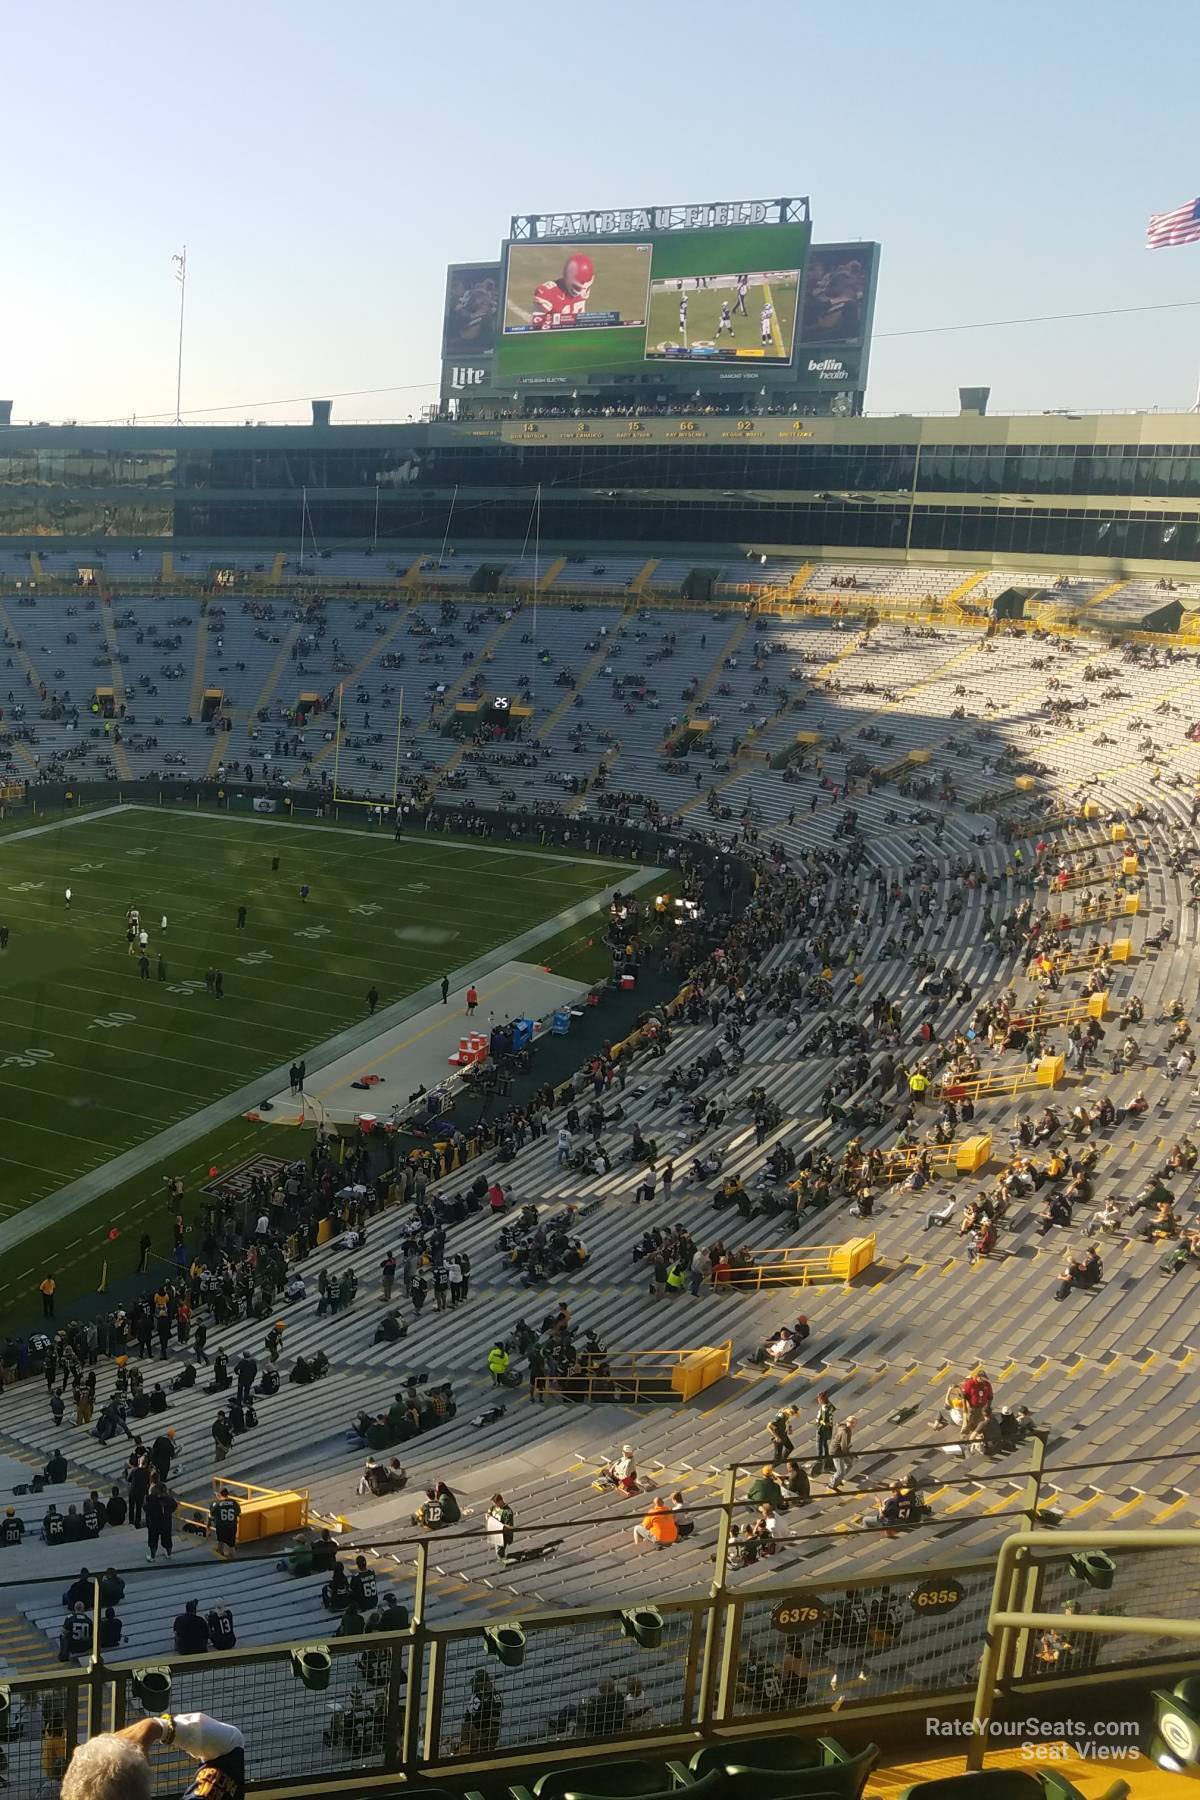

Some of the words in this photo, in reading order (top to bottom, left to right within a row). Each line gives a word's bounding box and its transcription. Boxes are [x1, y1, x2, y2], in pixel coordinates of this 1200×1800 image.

[545, 209, 672, 236] LAMBEAU
[683, 202, 768, 228] FIELD
[808, 359, 843, 371] bellin
[451, 367, 485, 389] Lite
[819, 369, 849, 380] health
[522, 423, 534, 432] 14
[577, 423, 585, 432] 3
[628, 421, 640, 430] 15
[680, 421, 695, 431] 66
[736, 420, 751, 430] 92
[793, 420, 801, 430] 4
[494, 697, 509, 709] 25
[400, 881, 431, 894] 10
[349, 902, 384, 917] 20
[294, 924, 331, 940] 30
[237, 949, 274, 966] 40
[165, 979, 209, 997] 50
[99, 1011, 137, 1029] 40
[5, 1048, 56, 1069] 30
[220, 1508, 235, 1521] 66
[429, 1507, 442, 1521] 12
[899, 1508, 911, 1520] 51
[50, 1521, 64, 1534] 66
[6, 1530, 20, 1541] 80
[363, 1581, 377, 1597] 69
[917, 1590, 958, 1606] 635s
[779, 1607, 819, 1624] 637s
[72, 1622, 90, 1641] 50
[219, 1618, 231, 1635] 13
